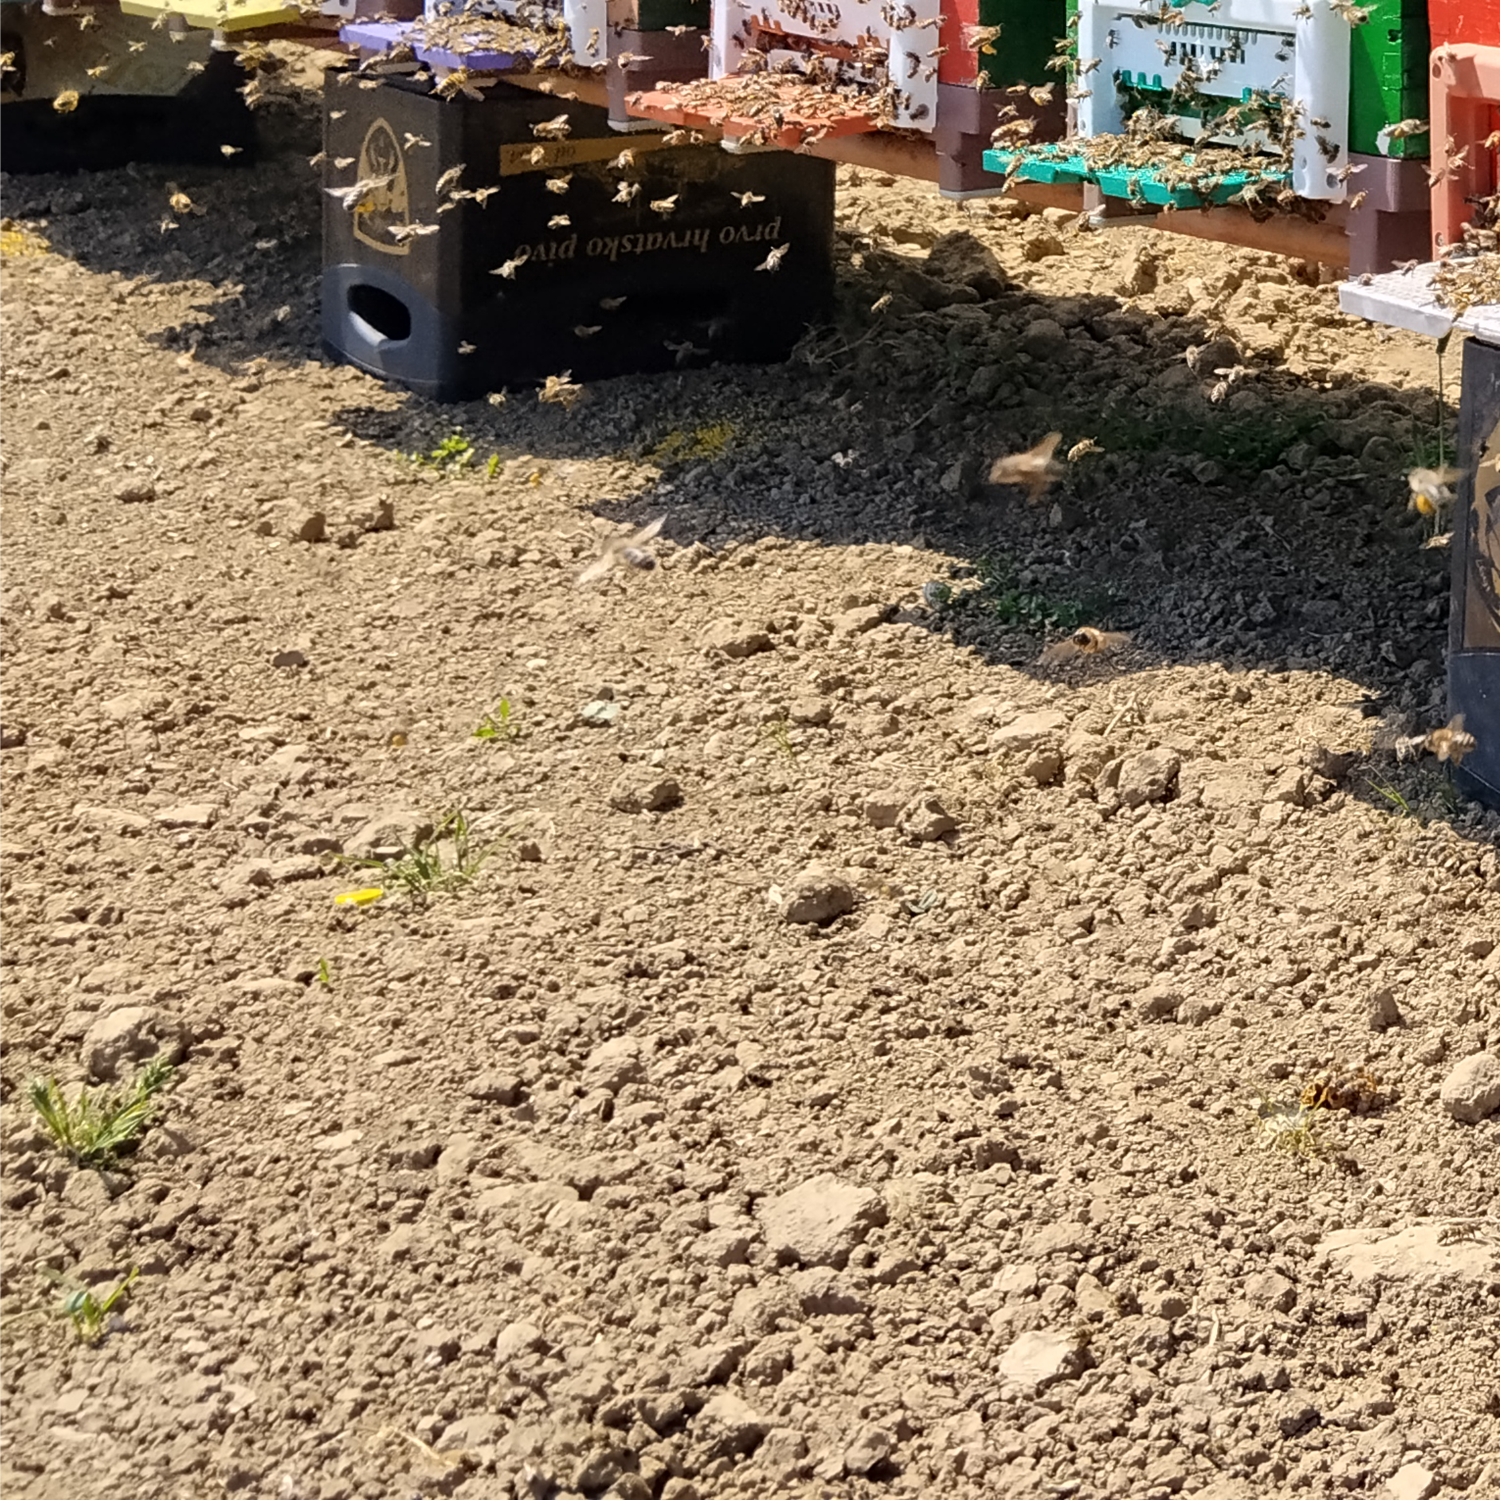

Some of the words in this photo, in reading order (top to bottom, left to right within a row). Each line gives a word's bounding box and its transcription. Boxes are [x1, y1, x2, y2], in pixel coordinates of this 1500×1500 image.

[586, 229, 710, 262] hrvatsko
[719, 217, 782, 245] prvo
[515, 234, 578, 267] pivo
